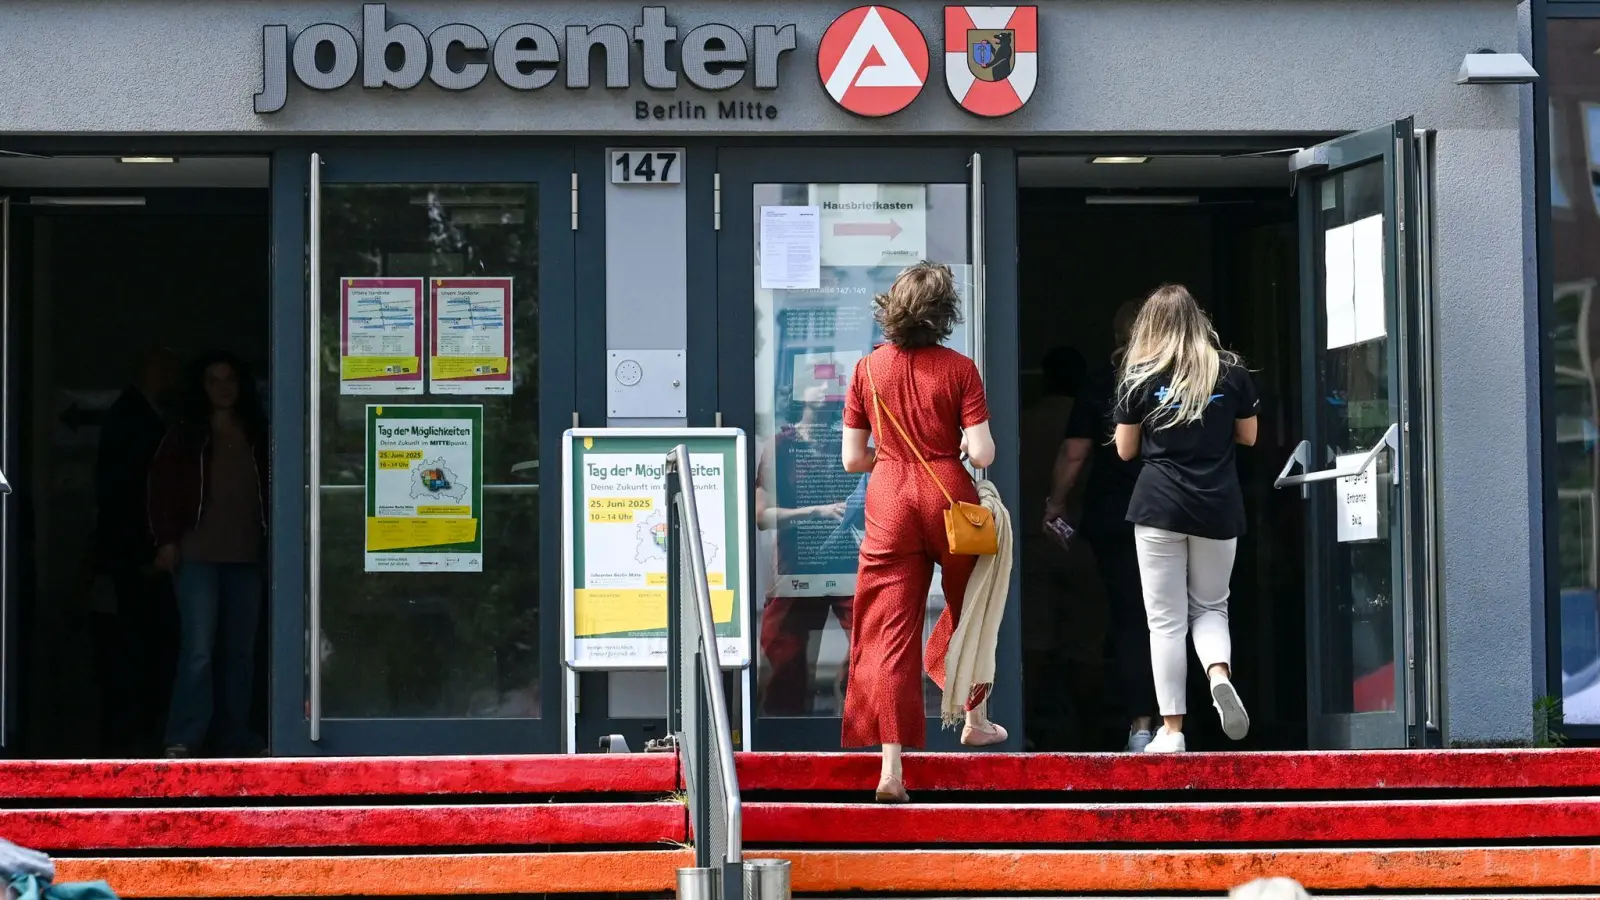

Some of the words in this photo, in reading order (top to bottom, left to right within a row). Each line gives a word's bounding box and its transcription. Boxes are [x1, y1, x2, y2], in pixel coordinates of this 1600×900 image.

[252, 3, 797, 114] jobcenter
[635, 101, 706, 120] Berlin
[718, 101, 778, 120] Mitte
[615, 152, 677, 182] 147
[823, 201, 914, 210] Hausbriefkasten
[378, 425, 392, 438] Tag
[393, 426, 410, 436] der
[411, 426, 471, 438] Möglichkeiten
[587, 462, 608, 480] Tag
[610, 463, 633, 477] der
[635, 463, 721, 480] Mögleiten
[590, 483, 614, 491] Deine
[616, 483, 649, 491] Zukunft
[650, 483, 661, 491] im
[590, 500, 604, 508] 25.
[607, 500, 626, 508] Juni
[628, 500, 651, 508] 2025
